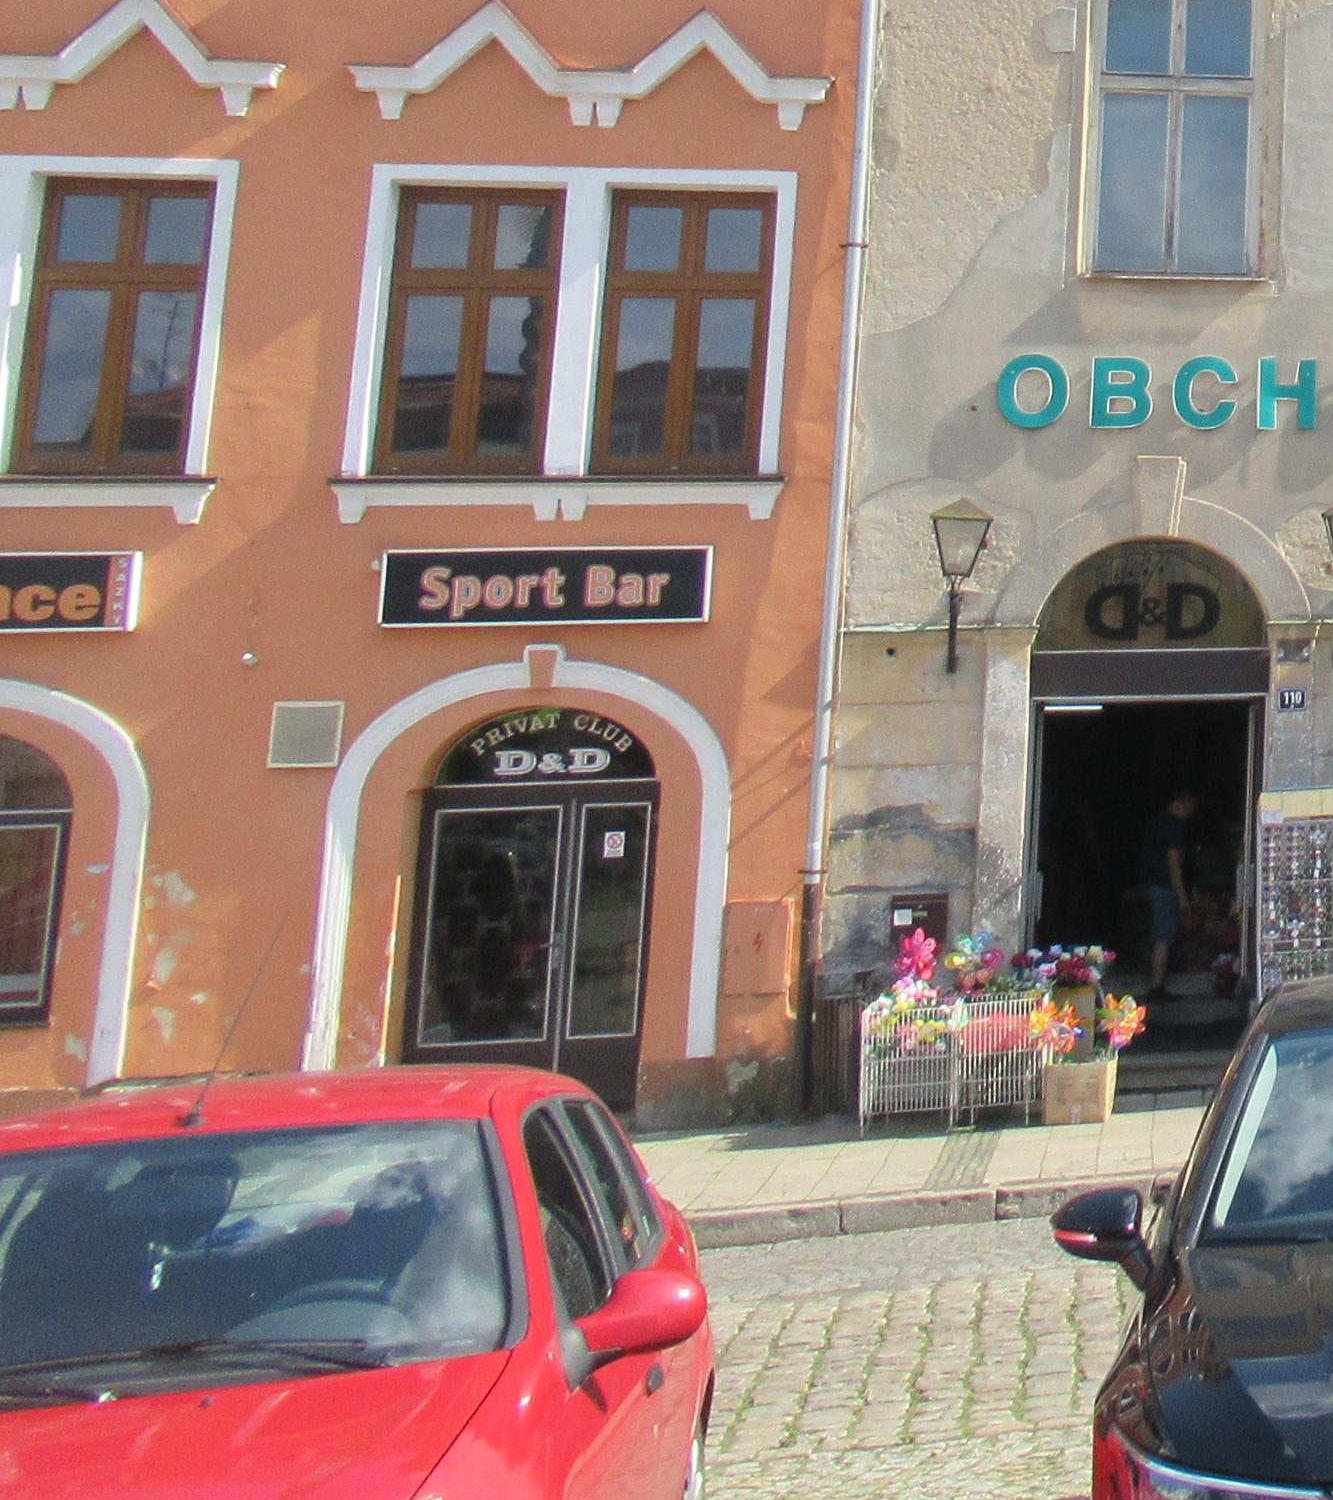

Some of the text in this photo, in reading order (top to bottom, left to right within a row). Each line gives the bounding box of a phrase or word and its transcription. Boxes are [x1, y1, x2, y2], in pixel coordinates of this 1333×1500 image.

[418, 564, 671, 618] Sport Bar
[1284, 691, 1302, 704] 110
[470, 712, 634, 757] PRIVAT CLUB
[493, 748, 611, 776] D&D
